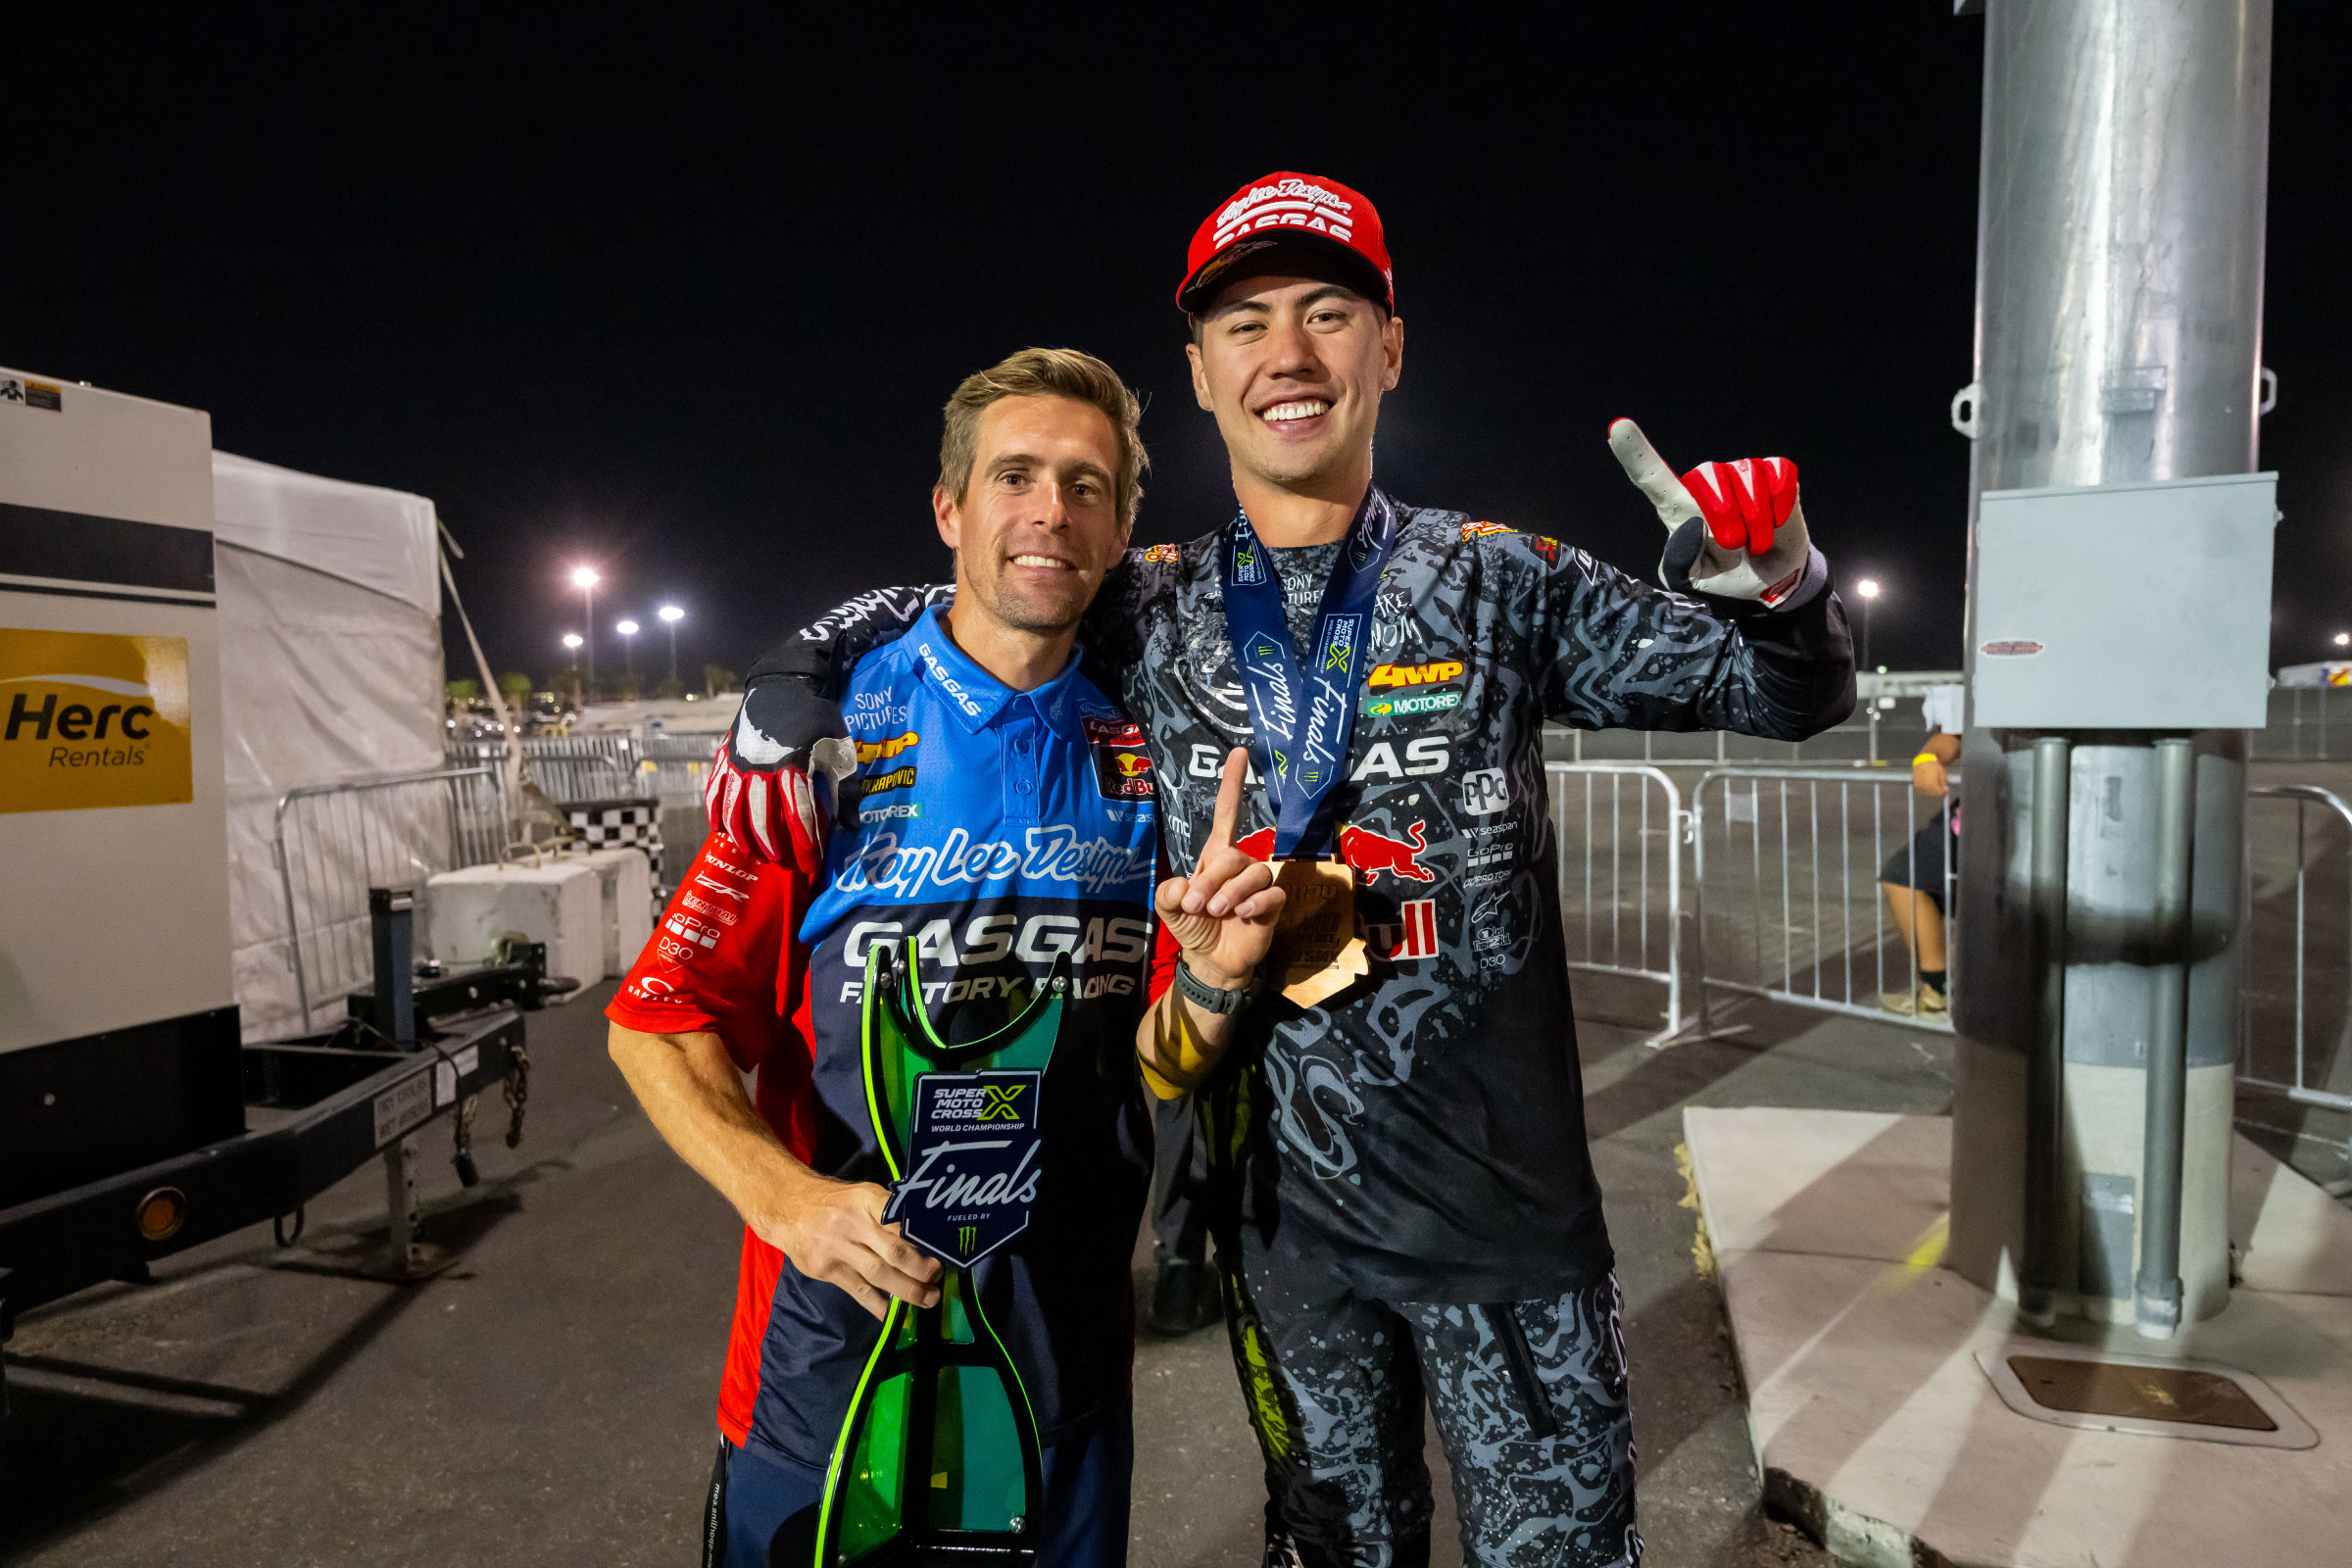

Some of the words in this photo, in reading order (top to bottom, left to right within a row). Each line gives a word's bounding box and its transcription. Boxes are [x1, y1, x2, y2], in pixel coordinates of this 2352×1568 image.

[1333, 618, 1343, 647] CROSS
[1338, 620, 1348, 647] MOTO
[1344, 618, 1354, 648] SUPER
[1371, 614, 1422, 652] NOM
[919, 643, 981, 716] GASGAS
[855, 686, 892, 710] SONY
[1247, 662, 1296, 741] Finals
[1394, 694, 1463, 713] MOTOREX
[5, 693, 153, 740] Herc
[844, 706, 906, 732] PICTURES
[1303, 676, 1348, 763] Finals
[49, 746, 144, 767] Rentals
[1134, 779, 1154, 795] Bu
[1480, 821, 1518, 836] seaspan
[835, 831, 937, 898] Troy
[931, 827, 1021, 888] Lee
[1467, 842, 1514, 858] GoPro
[672, 912, 720, 939] oPro
[844, 914, 1150, 968] GASGAS
[840, 974, 1026, 1004] FTORY
[933, 1088, 987, 1099] SUPER
[935, 1099, 984, 1108] MOTO
[931, 1108, 984, 1120] CROSS
[931, 1124, 962, 1133] WORLD
[962, 1122, 1025, 1132] CHAMPIONSHIP
[887, 1139, 1042, 1219] Finals
[947, 1213, 978, 1222] FUELED
[980, 1212, 991, 1221] BY
